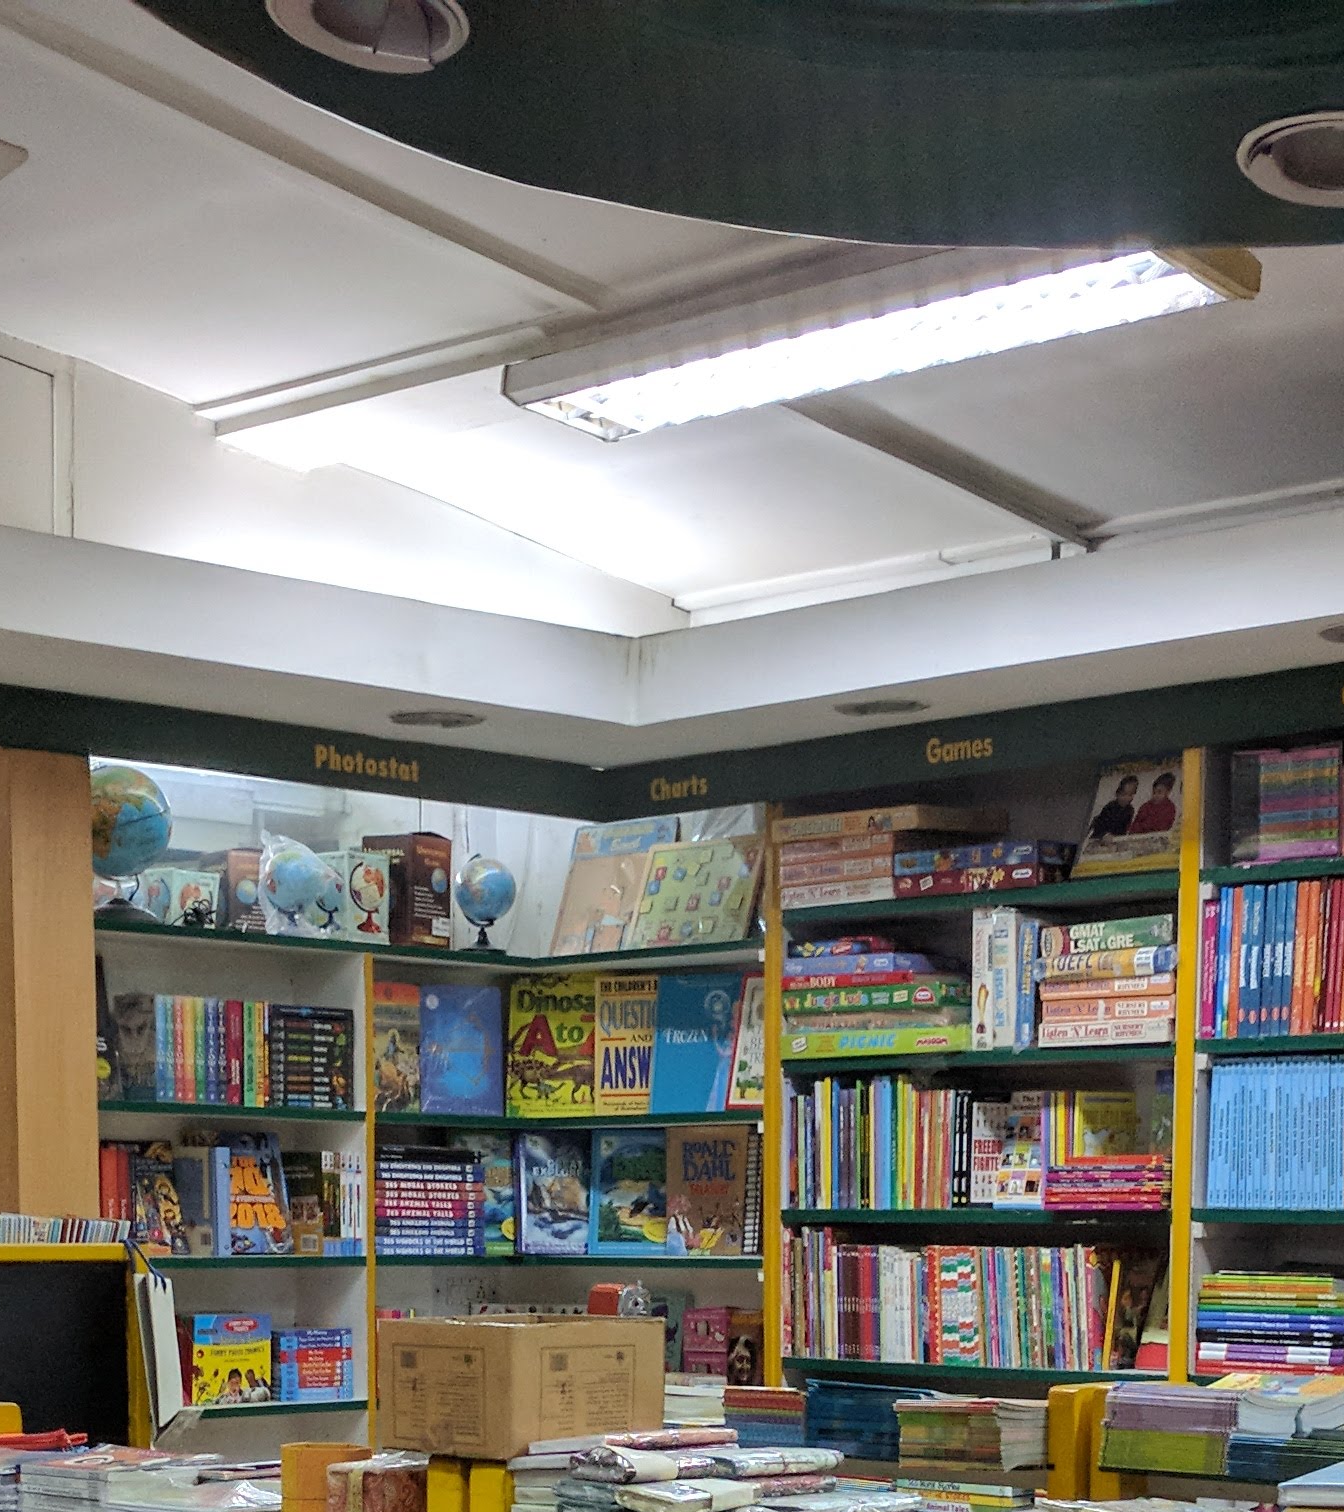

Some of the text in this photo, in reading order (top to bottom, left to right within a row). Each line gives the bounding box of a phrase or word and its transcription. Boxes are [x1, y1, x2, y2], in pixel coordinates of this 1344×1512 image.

[313, 743, 420, 783] Photostat
[926, 736, 993, 764] Games
[650, 774, 708, 801] Charts
[1070, 923, 1106, 938] GMAT
[1071, 934, 1134, 952] LSAT GRE
[520, 1014, 583, 1056] A to
[630, 1033, 652, 1043] AND
[662, 1028, 709, 1045] FROZEN
[600, 1047, 650, 1090] ANSW
